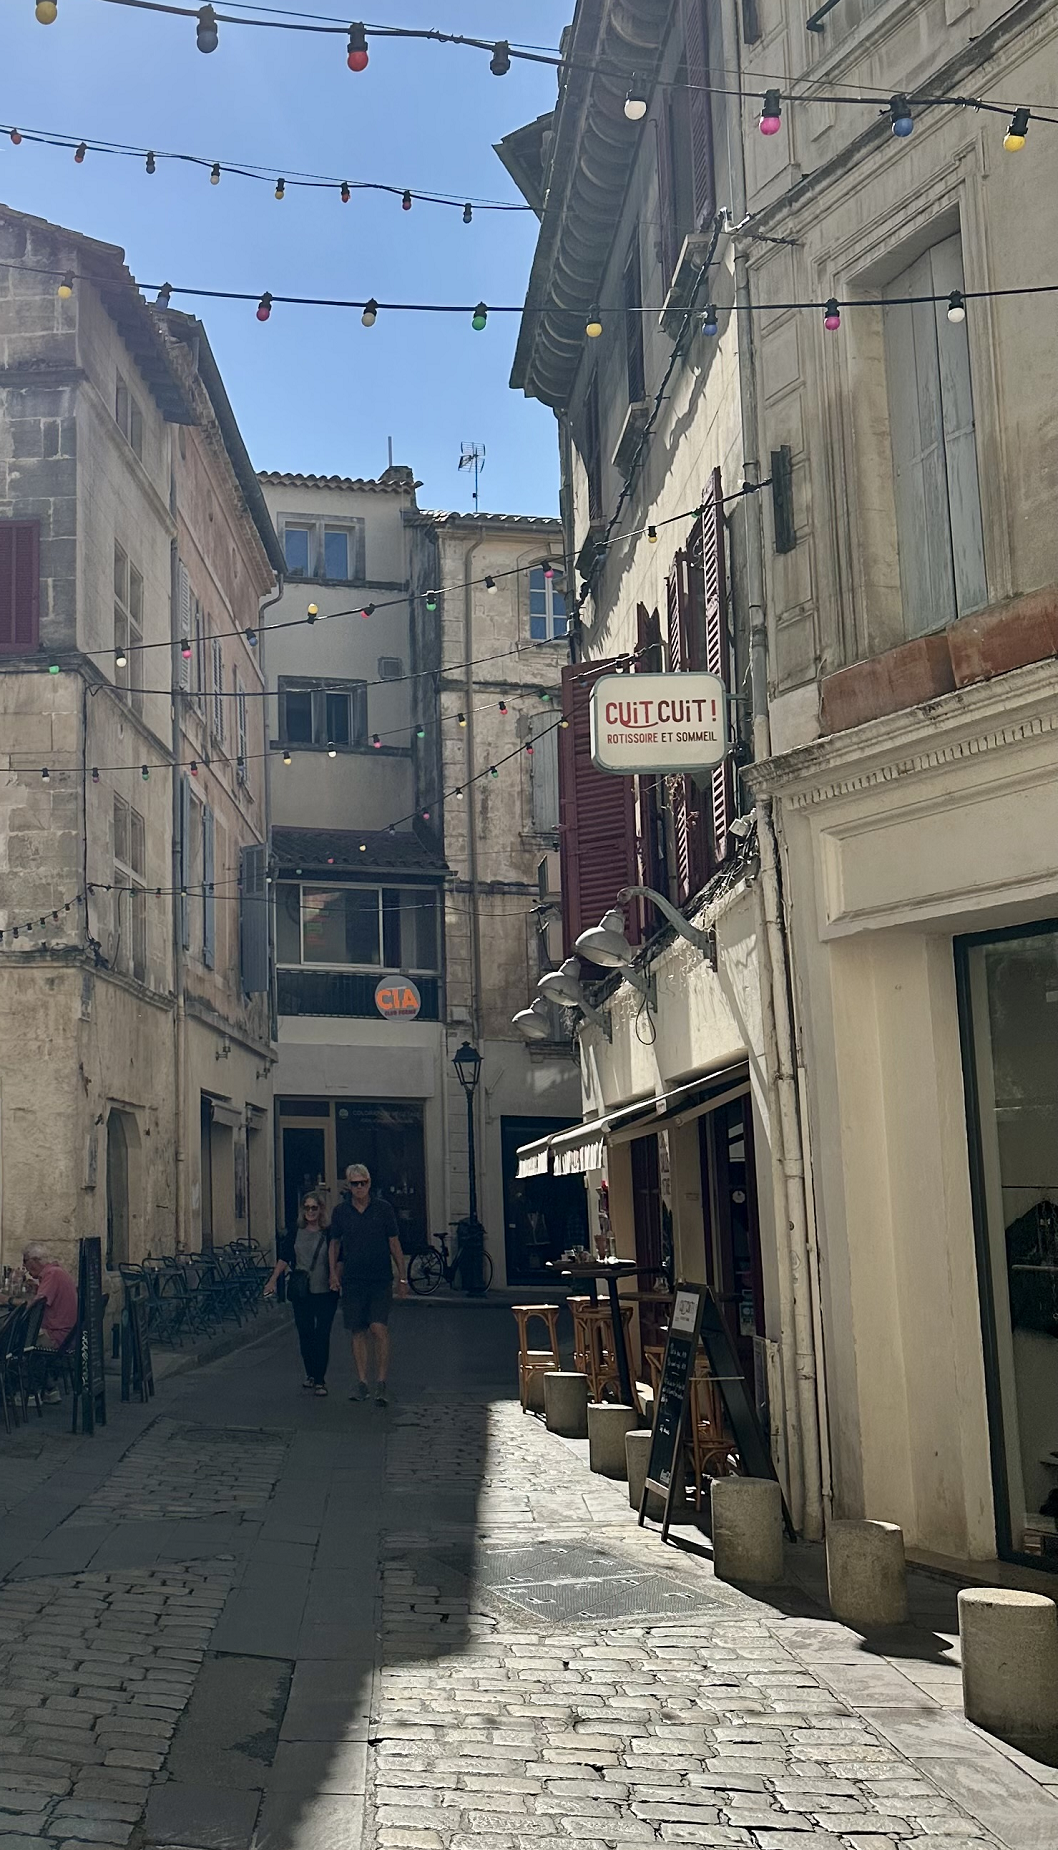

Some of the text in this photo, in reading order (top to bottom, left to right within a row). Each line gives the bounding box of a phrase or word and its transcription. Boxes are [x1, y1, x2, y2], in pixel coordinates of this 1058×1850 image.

[607, 731, 717, 744] ROTISSOIRE ET SOMMEIL
